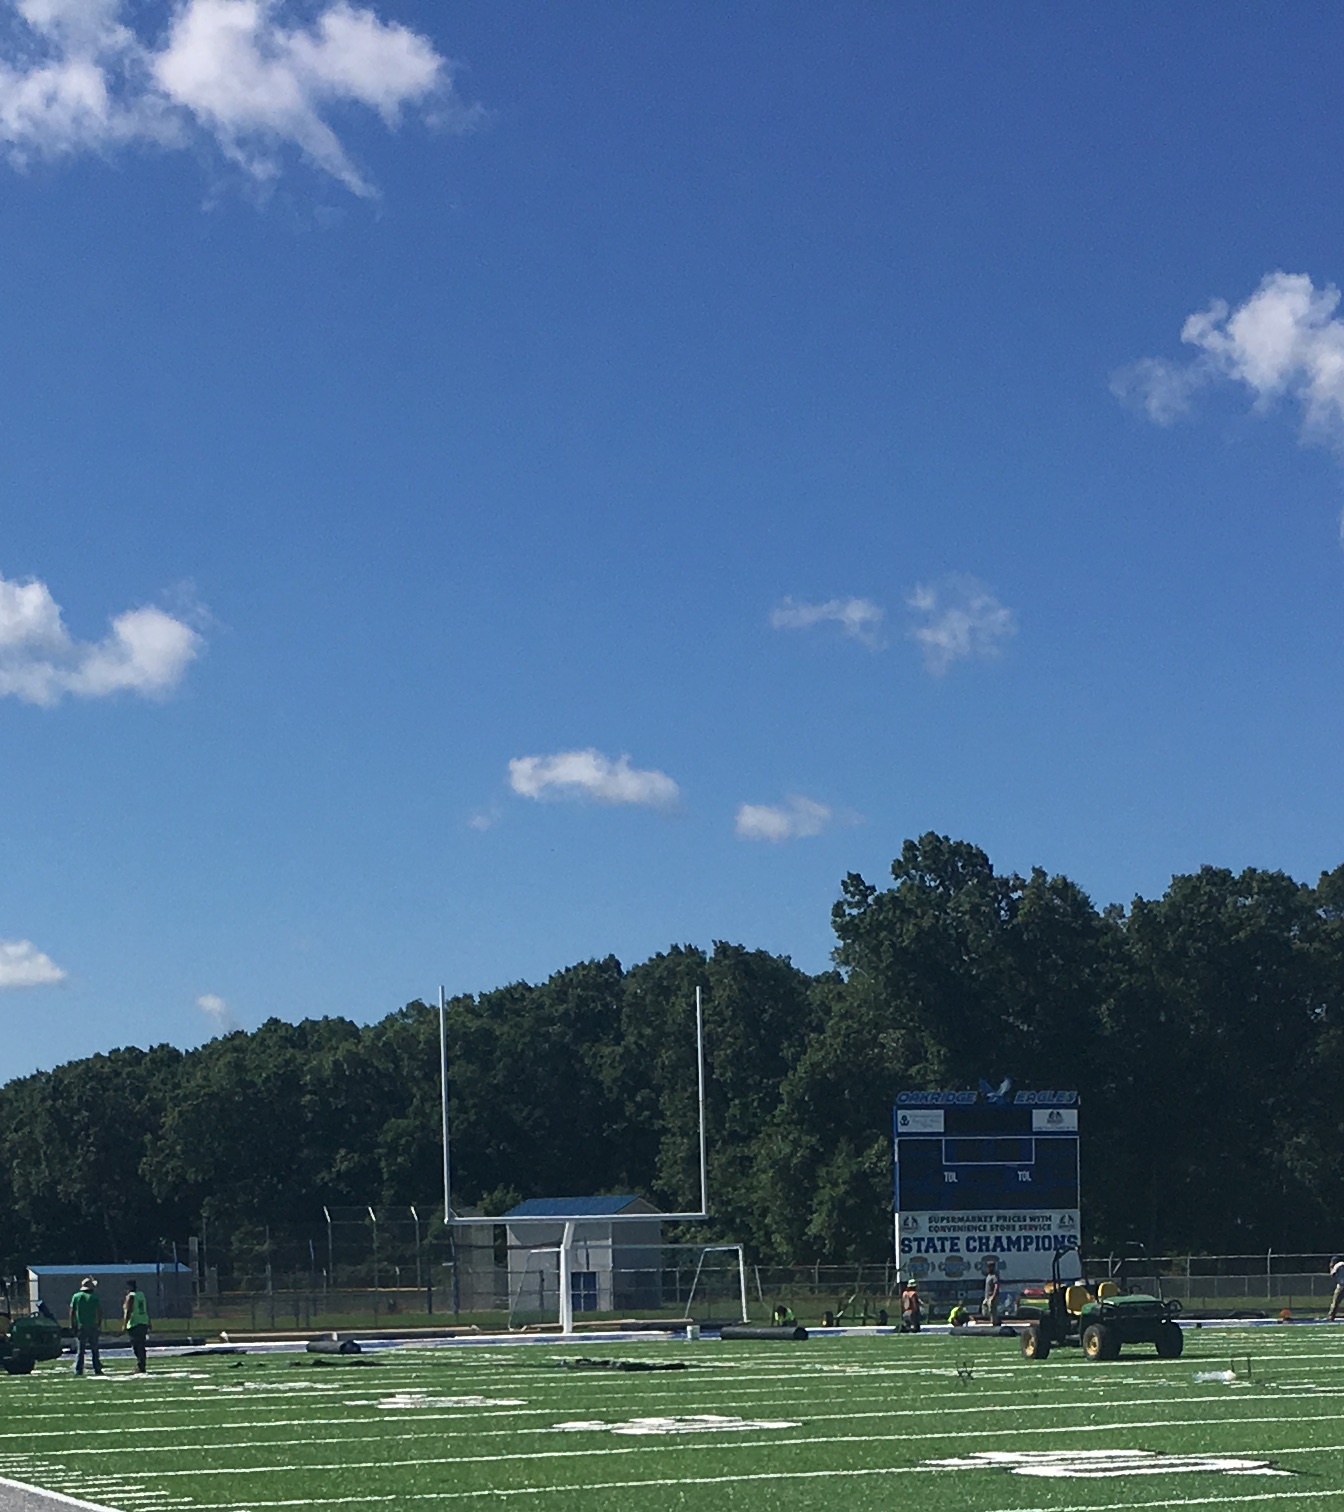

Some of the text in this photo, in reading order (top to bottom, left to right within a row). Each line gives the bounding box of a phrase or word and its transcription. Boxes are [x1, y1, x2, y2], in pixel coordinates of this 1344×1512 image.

[896, 1090, 1078, 1105] OAKRIDGE EAGLES
[944, 1171, 958, 1183] TOL
[1018, 1170, 1032, 1182] TOL
[928, 1214, 1052, 1224] SUPERMARKET PRICES WITH
[928, 1222, 1052, 1233] CONVENIENCE STORE SERVICE
[901, 1234, 1078, 1254] STATE CHAMPIONS
